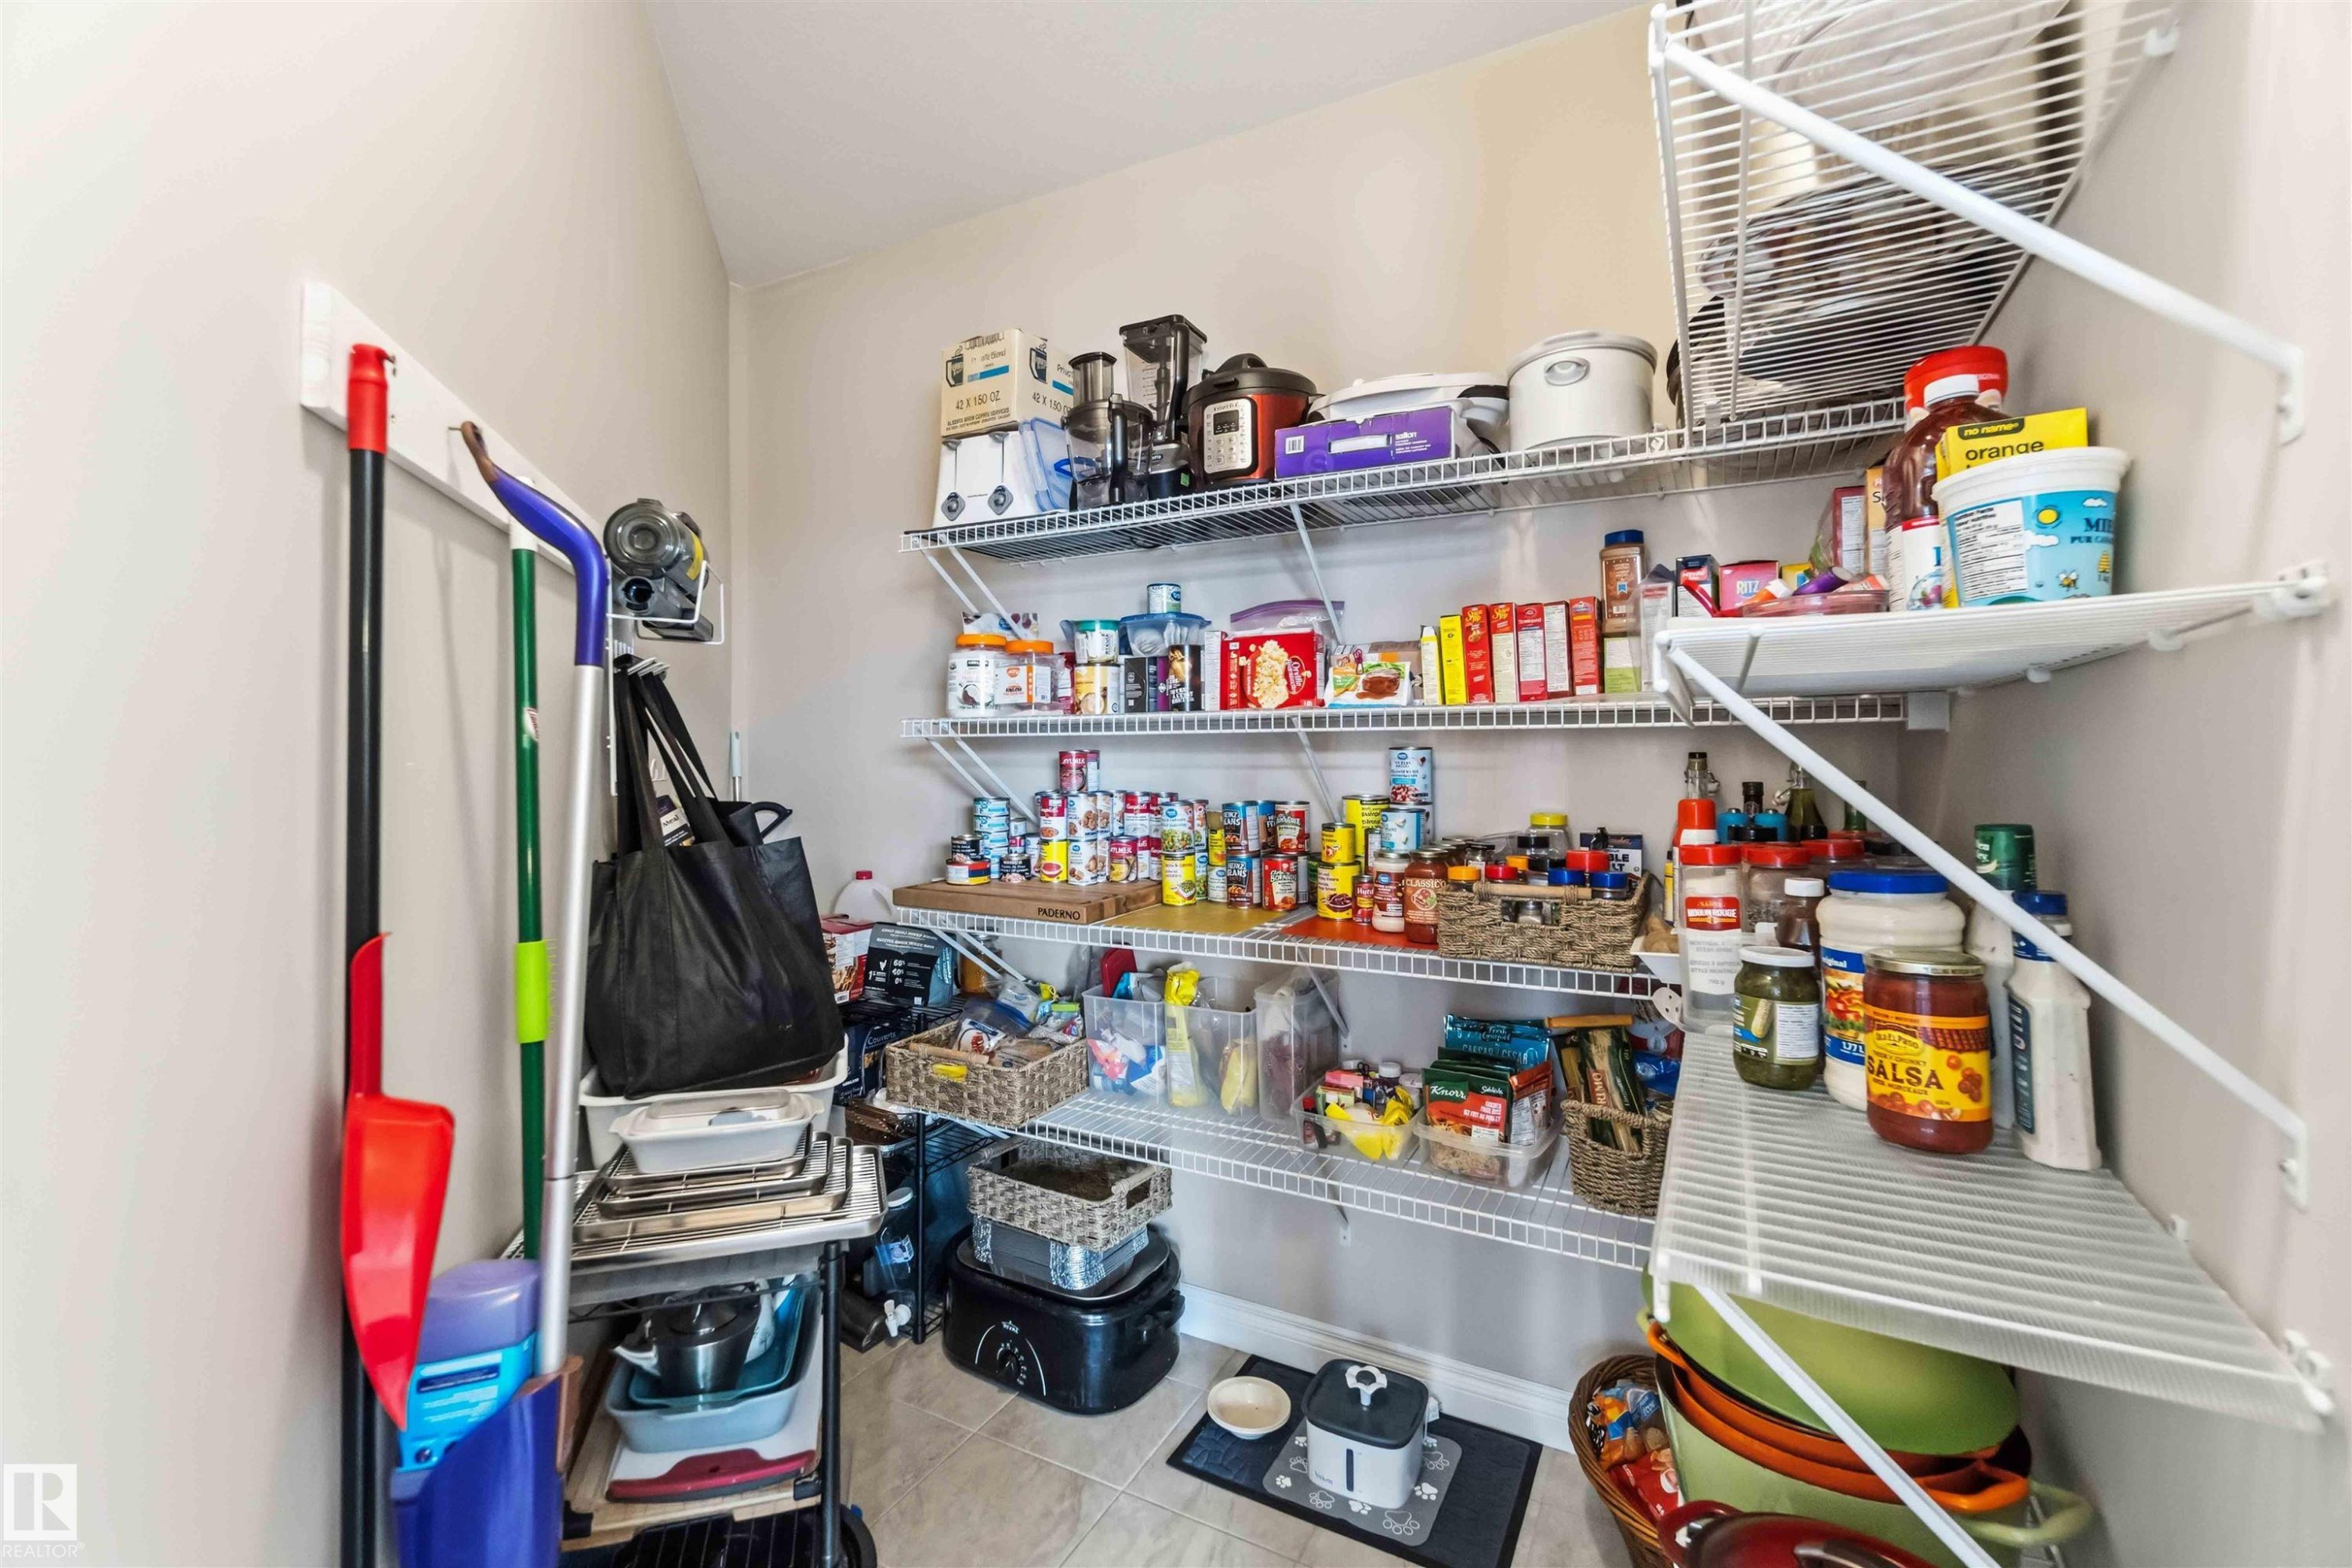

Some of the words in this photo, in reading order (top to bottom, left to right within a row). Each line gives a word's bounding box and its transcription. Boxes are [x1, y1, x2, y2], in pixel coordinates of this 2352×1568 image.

[956, 399, 964, 410] 42
[966, 397, 972, 408] X
[989, 390, 1001, 402] OZ
[1032, 392, 1041, 404] 42
[1042, 394, 1047, 406] X
[1964, 426, 1980, 437] no
[1965, 441, 2045, 462] orange
[2083, 517, 2114, 533] MIE
[1736, 579, 1761, 595] RITZ
[1609, 854, 1629, 862] BLE
[1612, 863, 1625, 872] LT
[1406, 878, 1446, 888] CLASSICO
[1037, 907, 1080, 920] PADERNO
[1462, 1044, 1494, 1055] CAESAR
[1867, 1054, 1945, 1091] SALSA
[1429, 1084, 1466, 1100] Knorr
[1592, 1072, 1606, 1105] RIMO
